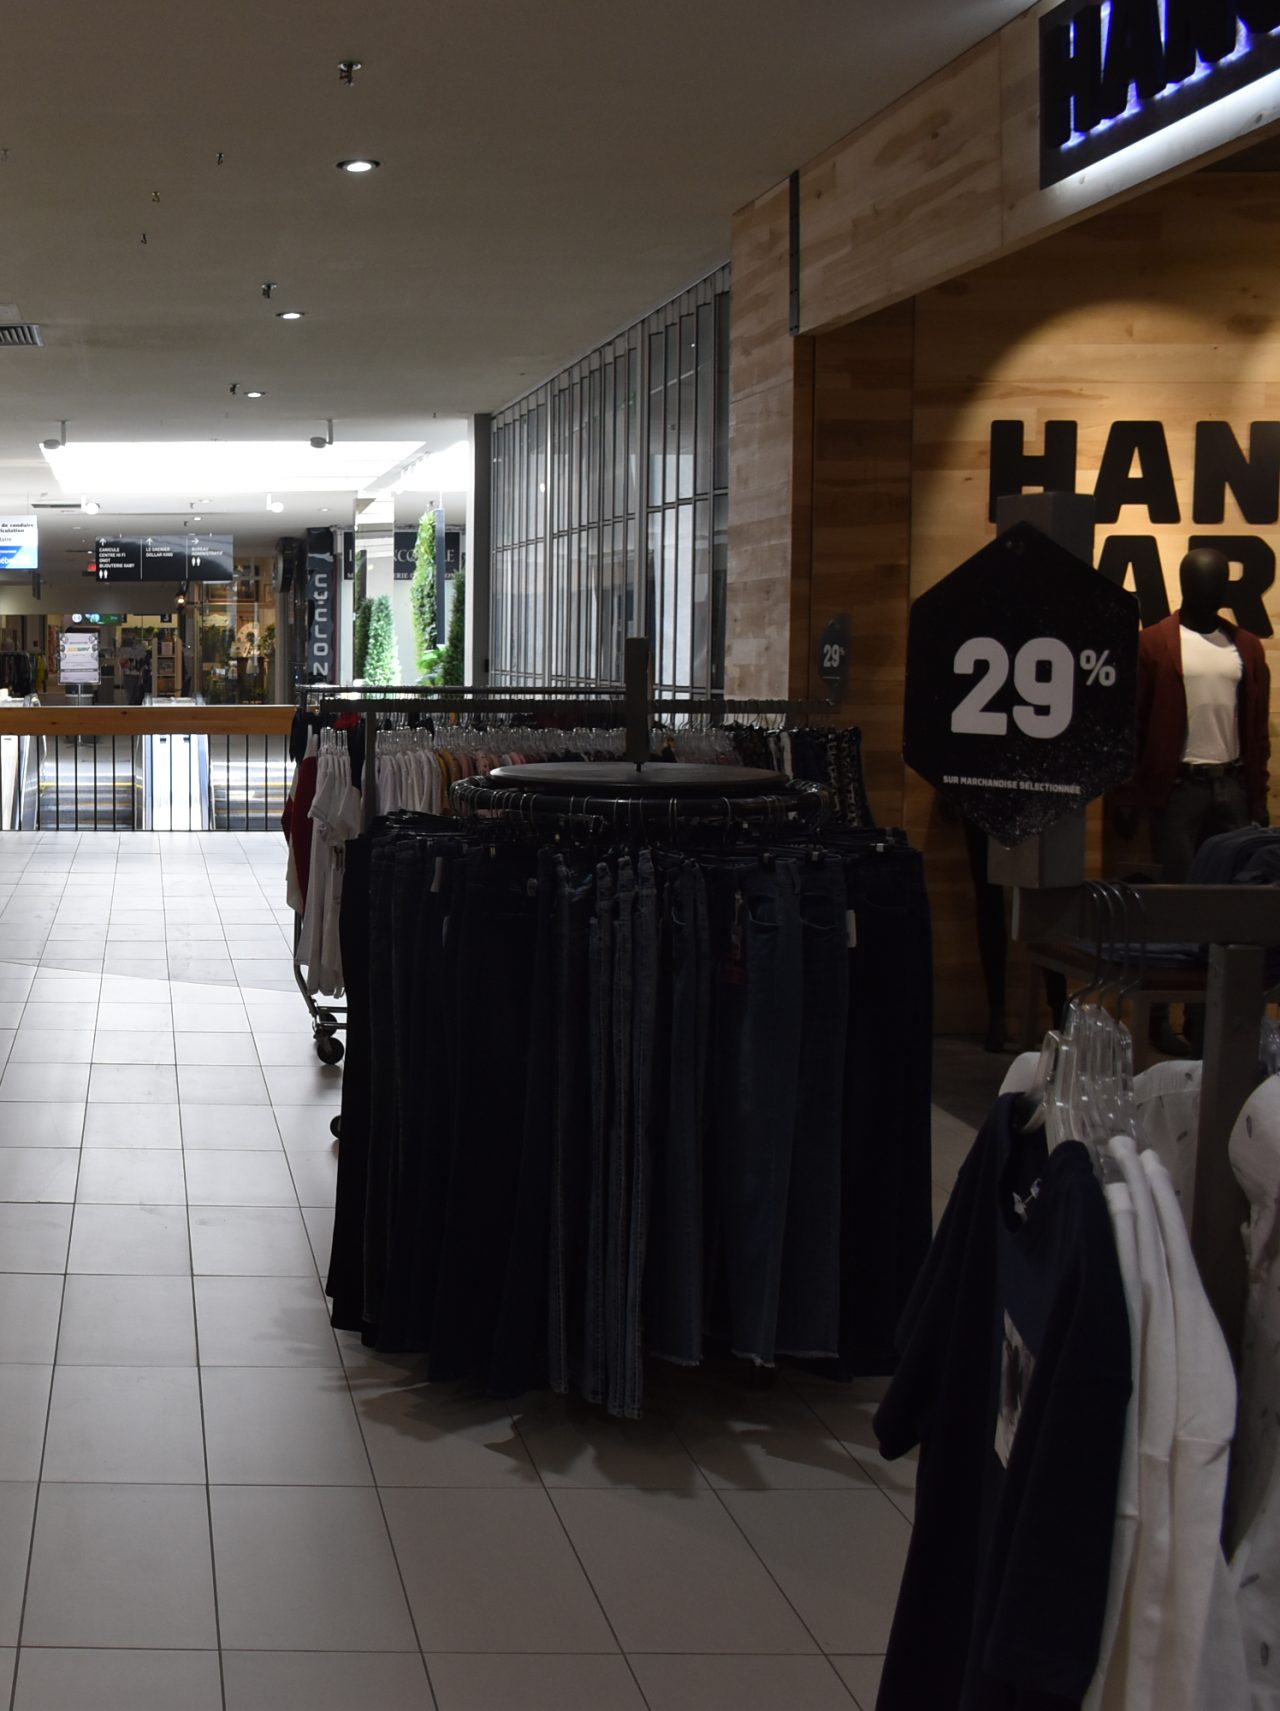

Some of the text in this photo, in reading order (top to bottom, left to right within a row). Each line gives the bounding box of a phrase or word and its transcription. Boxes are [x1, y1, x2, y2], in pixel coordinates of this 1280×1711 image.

[951, 637, 1117, 739] 29%
[943, 775, 959, 784] SUR
[960, 777, 1018, 789] MARCHANDISE
